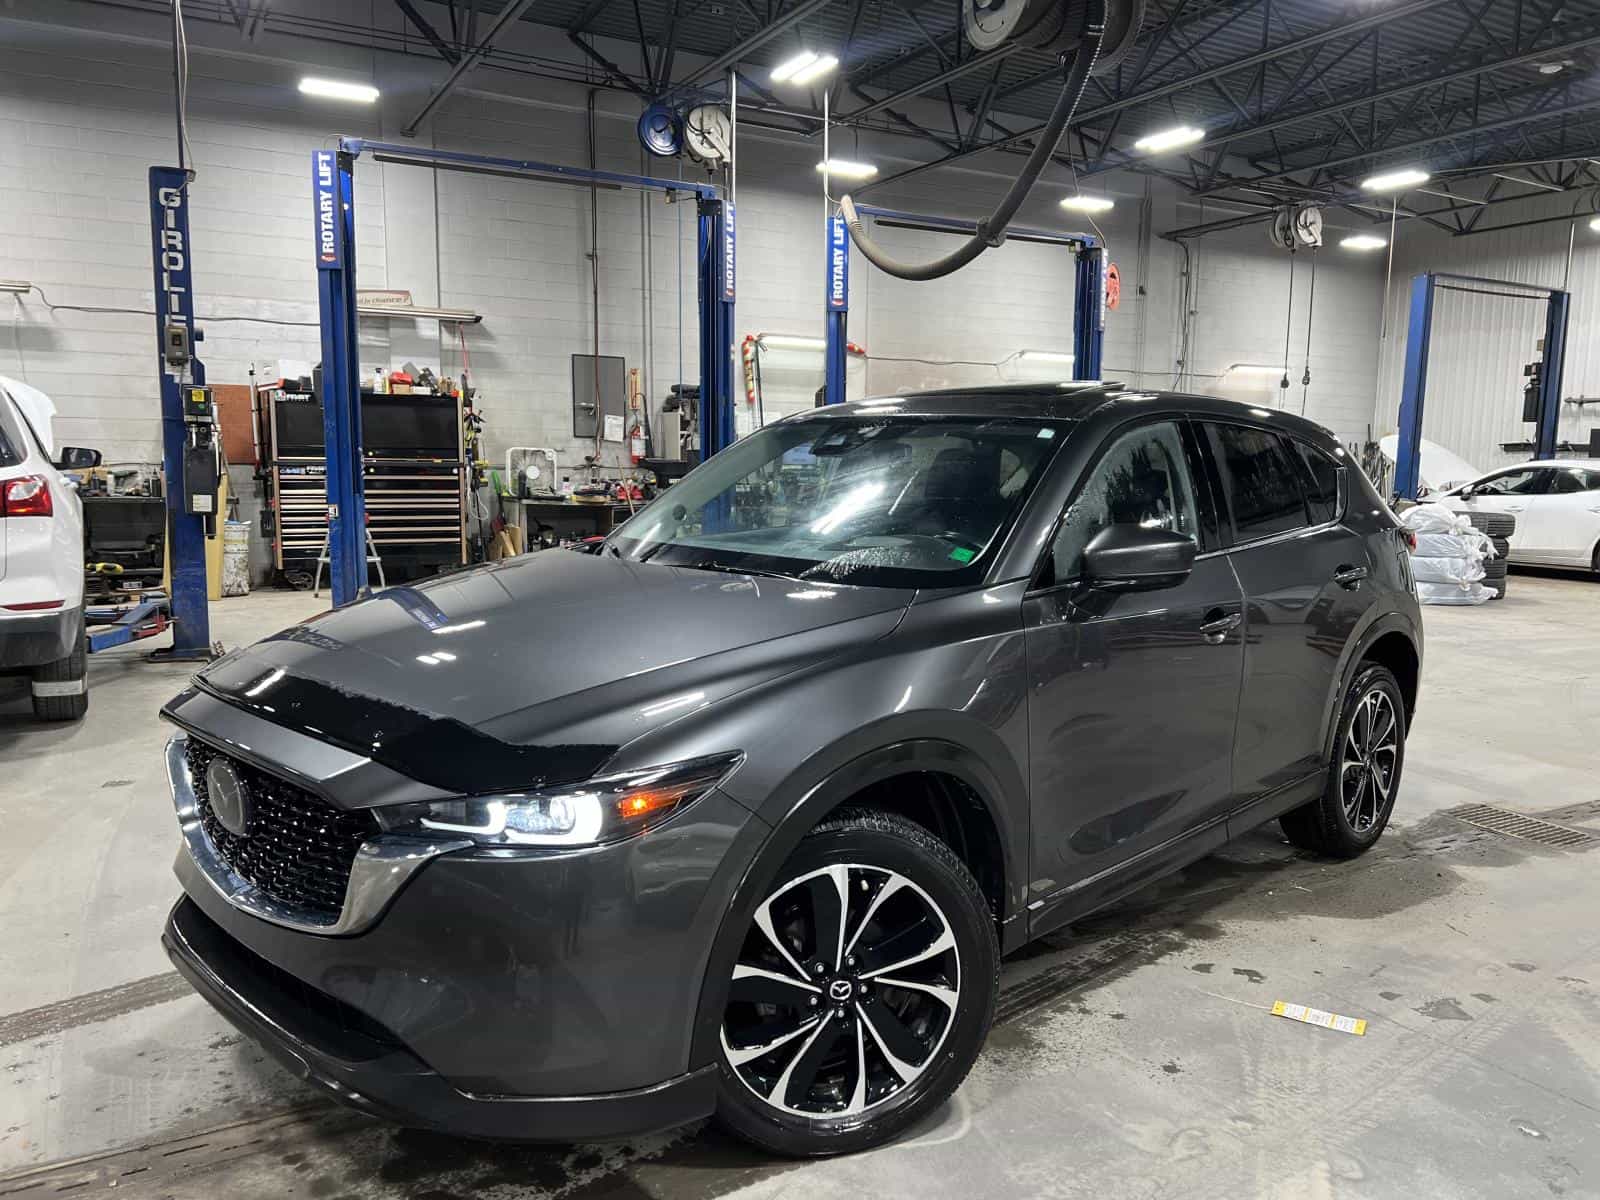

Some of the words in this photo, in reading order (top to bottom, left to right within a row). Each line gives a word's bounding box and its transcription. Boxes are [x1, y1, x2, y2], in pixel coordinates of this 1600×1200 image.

[318, 152, 332, 186] LIFT
[320, 190, 335, 253] ROTARY
[832, 218, 845, 245] LIFT
[832, 247, 845, 299] ROTARY
